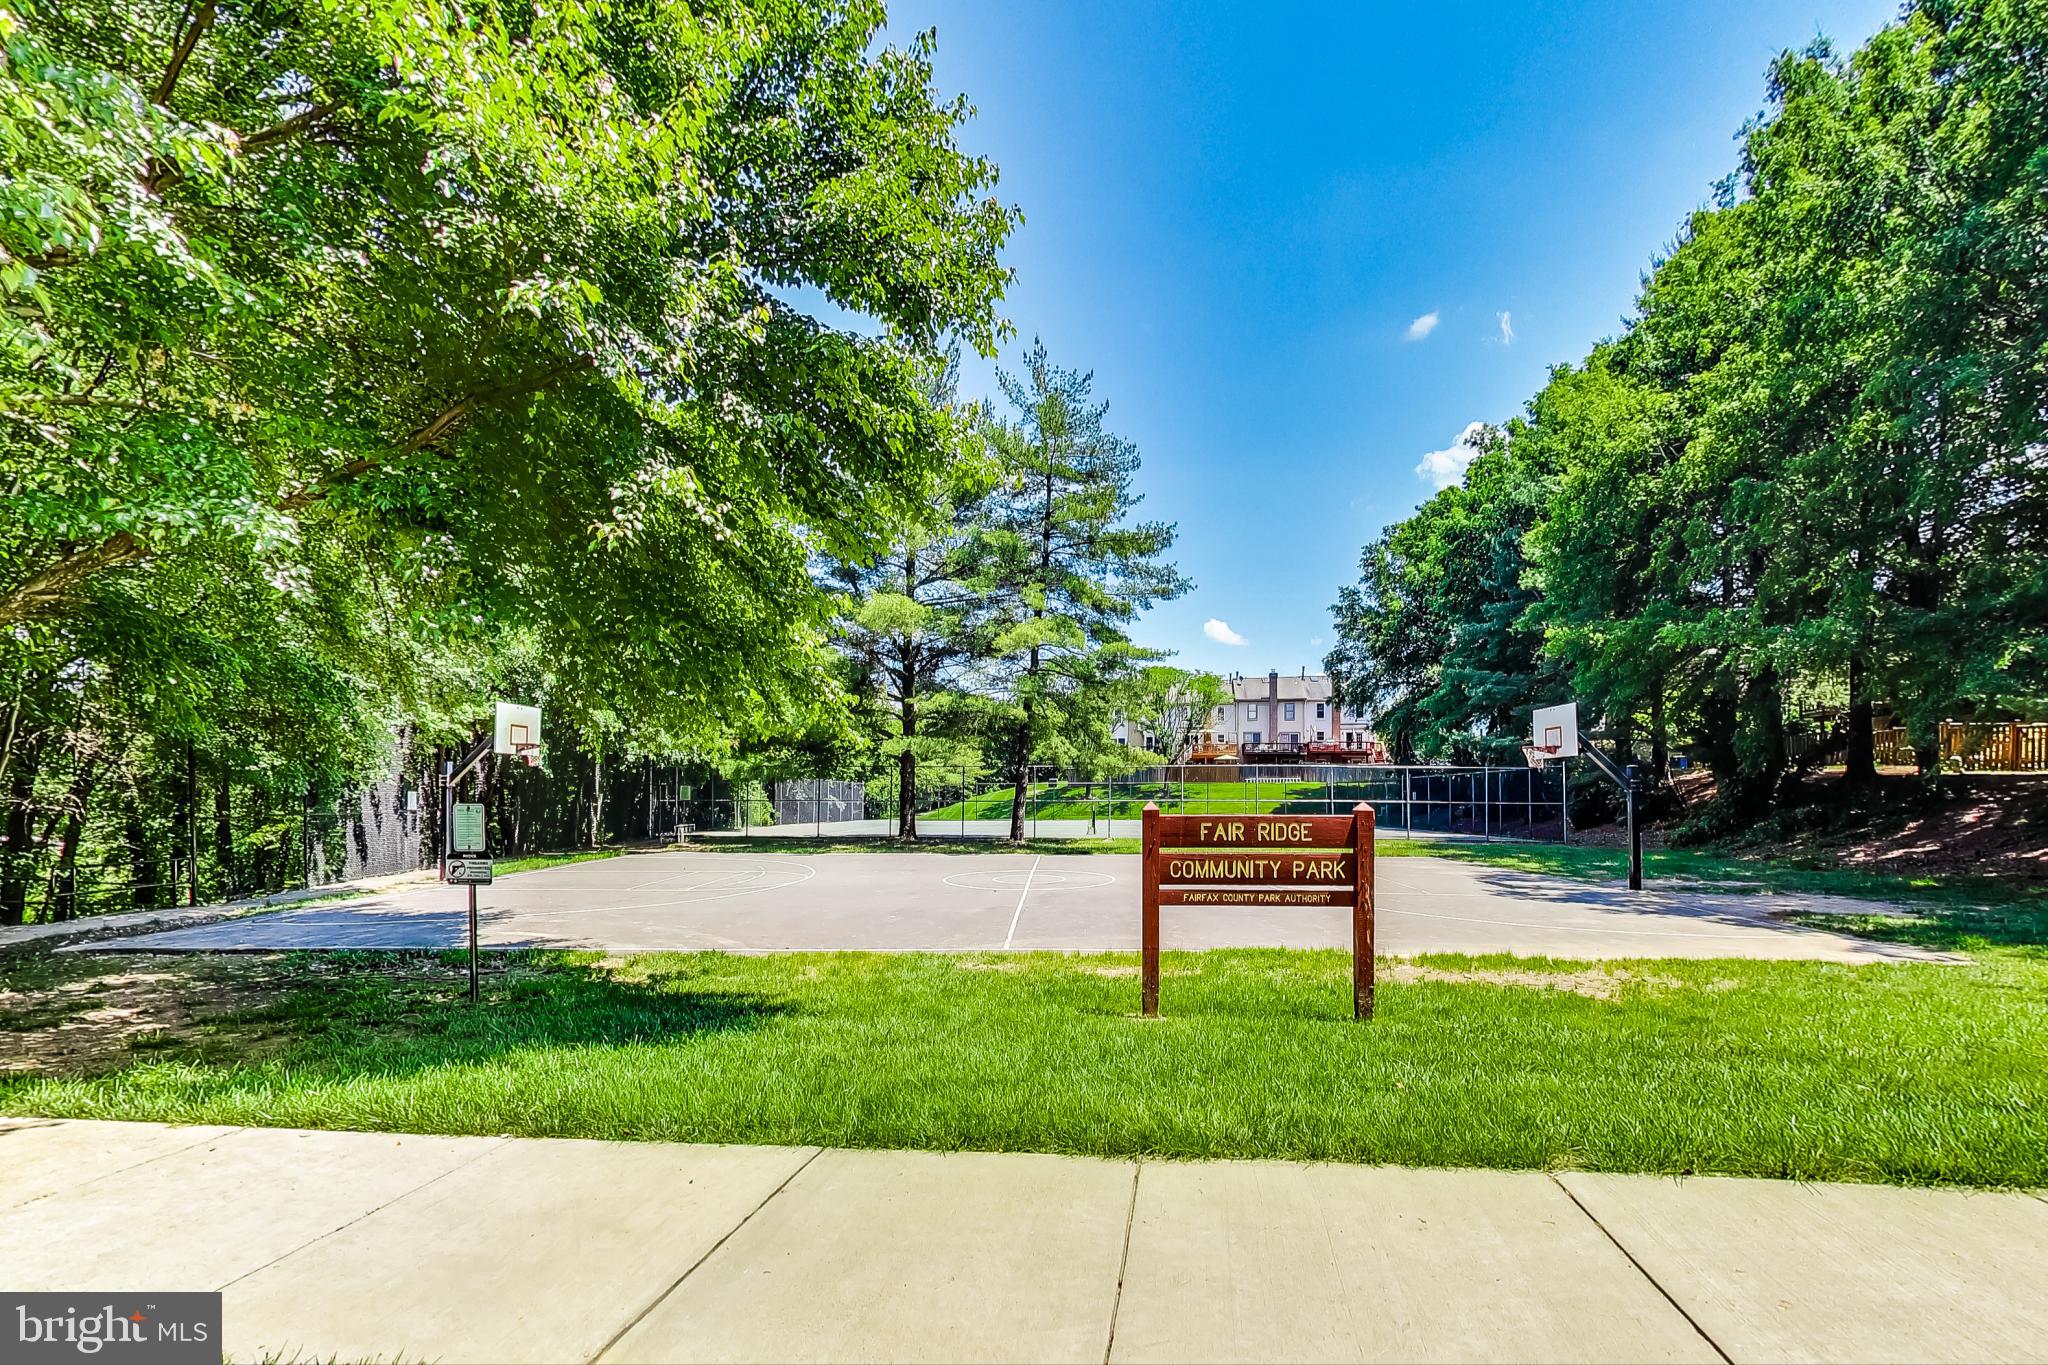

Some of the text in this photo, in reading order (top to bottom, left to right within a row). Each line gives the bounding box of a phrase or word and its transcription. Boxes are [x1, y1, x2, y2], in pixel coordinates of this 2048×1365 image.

[1200, 823, 1312, 841] FAIR RIDGE
[1170, 860, 1346, 879] COMMUNITY PARK
[1183, 893, 1331, 903] FAIRFAX COUNTY PARK AUTHORITY
